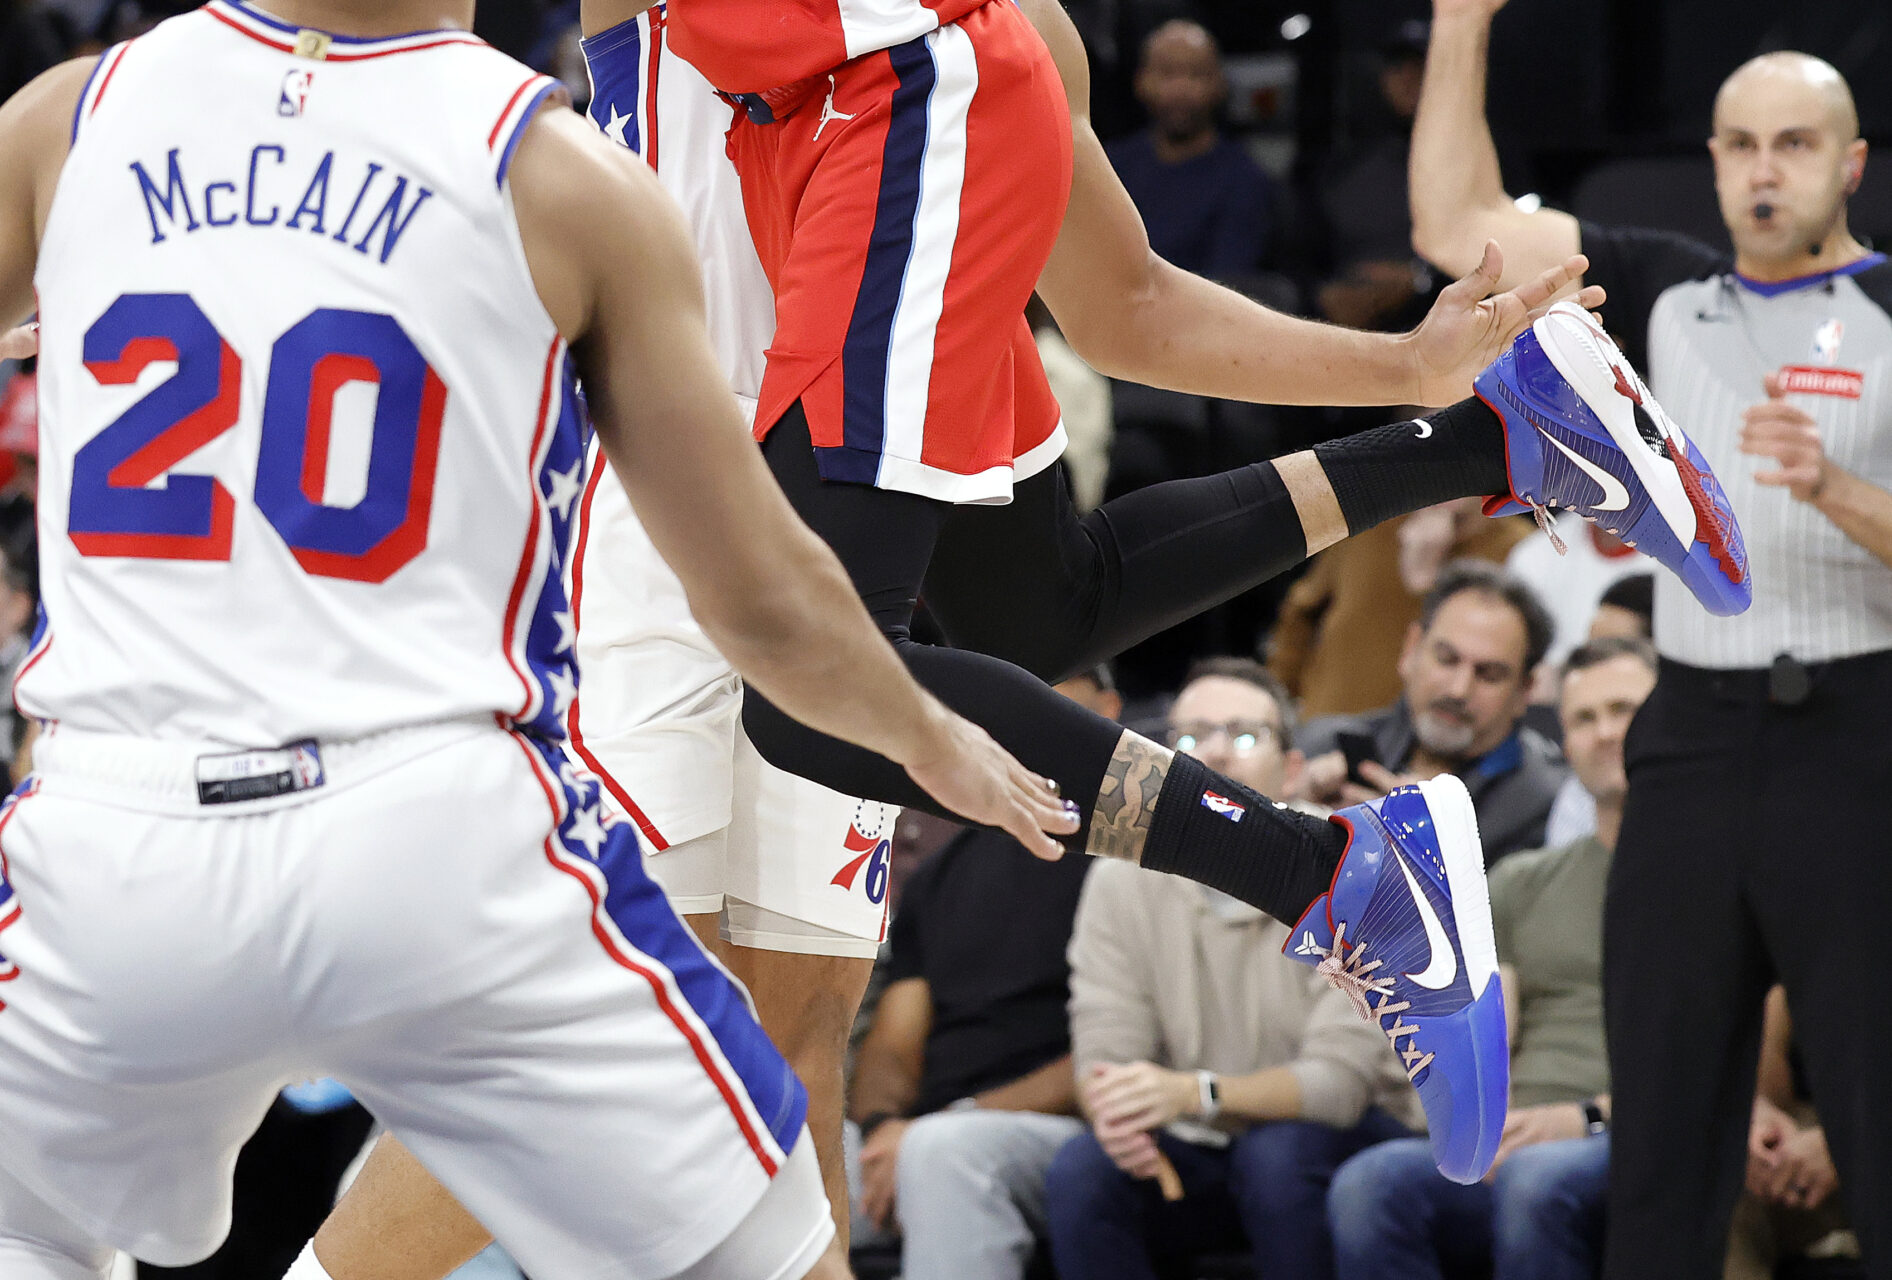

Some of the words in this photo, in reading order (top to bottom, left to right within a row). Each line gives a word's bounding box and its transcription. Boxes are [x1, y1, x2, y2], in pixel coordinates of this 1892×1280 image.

[129, 145, 432, 264] McCAIN
[67, 293, 447, 584] 20
[830, 822, 891, 905] 76
